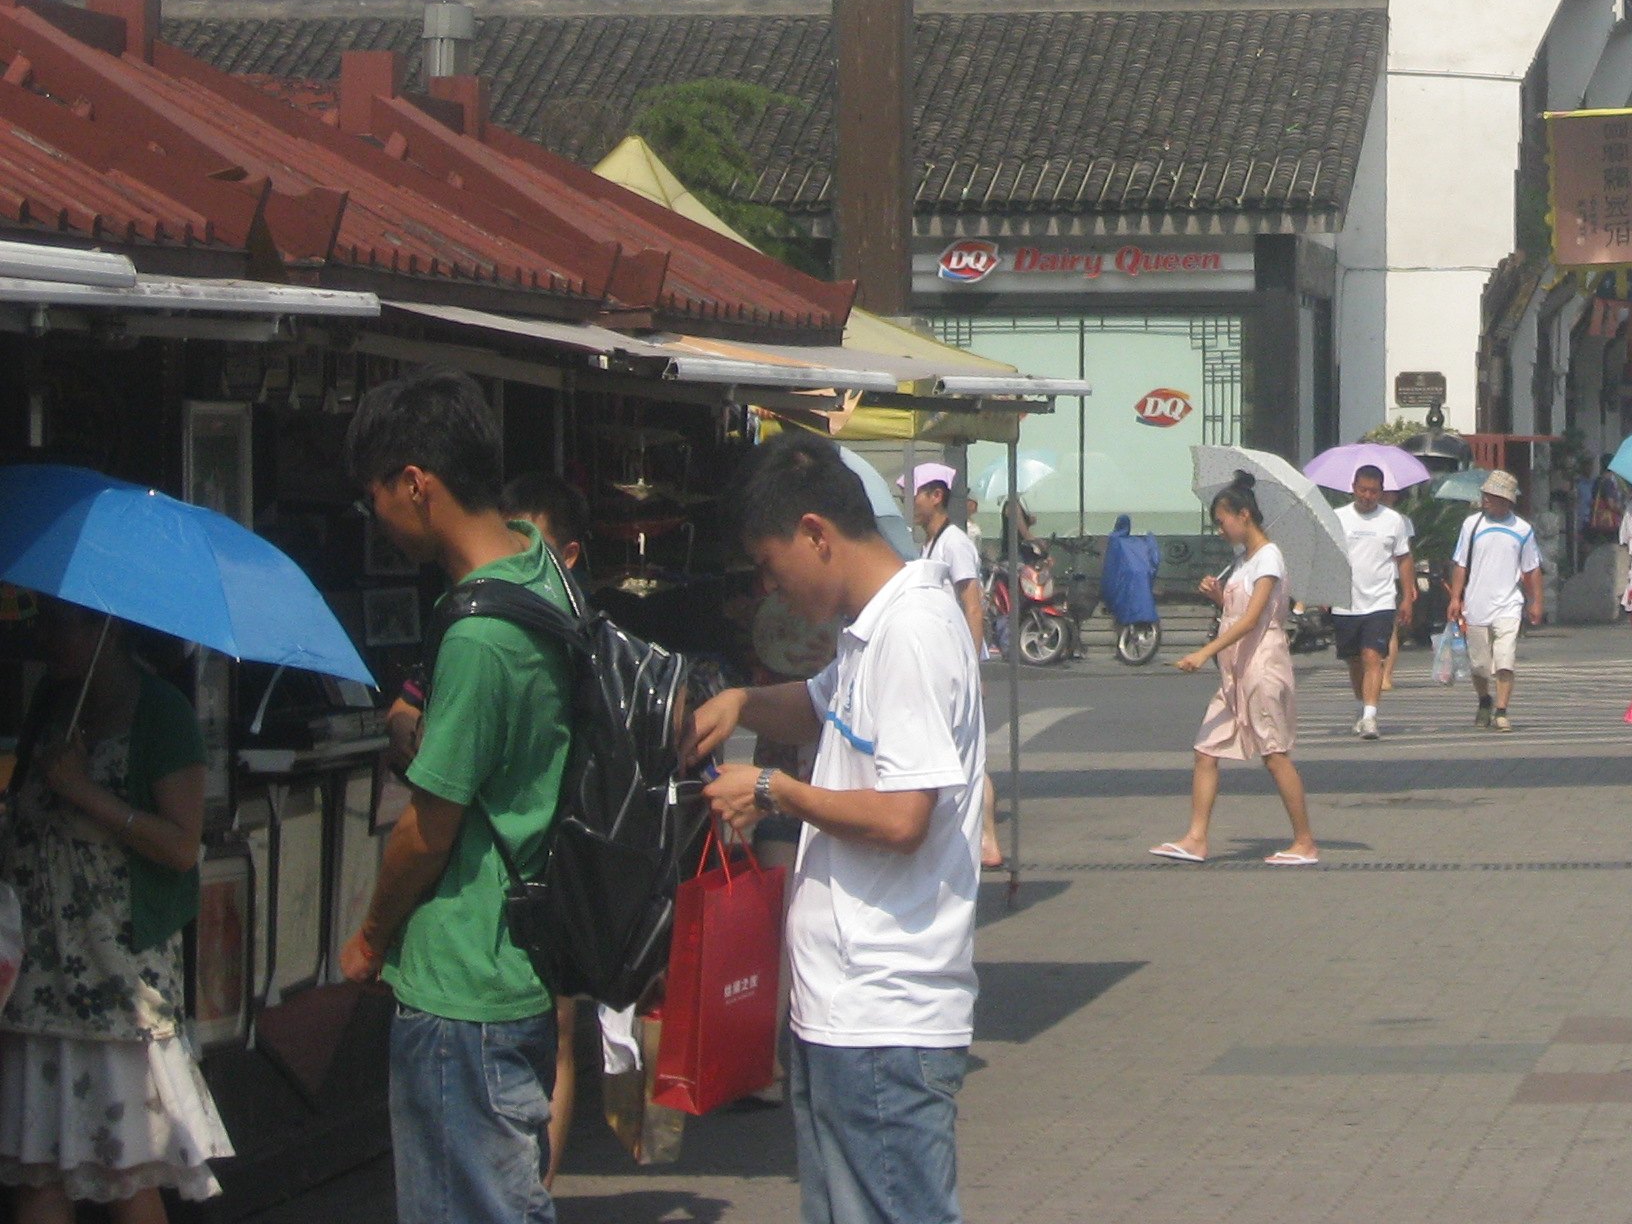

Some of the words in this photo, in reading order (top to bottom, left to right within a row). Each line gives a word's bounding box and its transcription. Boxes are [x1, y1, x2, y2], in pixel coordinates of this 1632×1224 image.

[949, 249, 988, 270] DQ
[1012, 246, 1103, 278] Dairy
[1114, 245, 1222, 276] Queen
[1143, 396, 1185, 422] DQ
